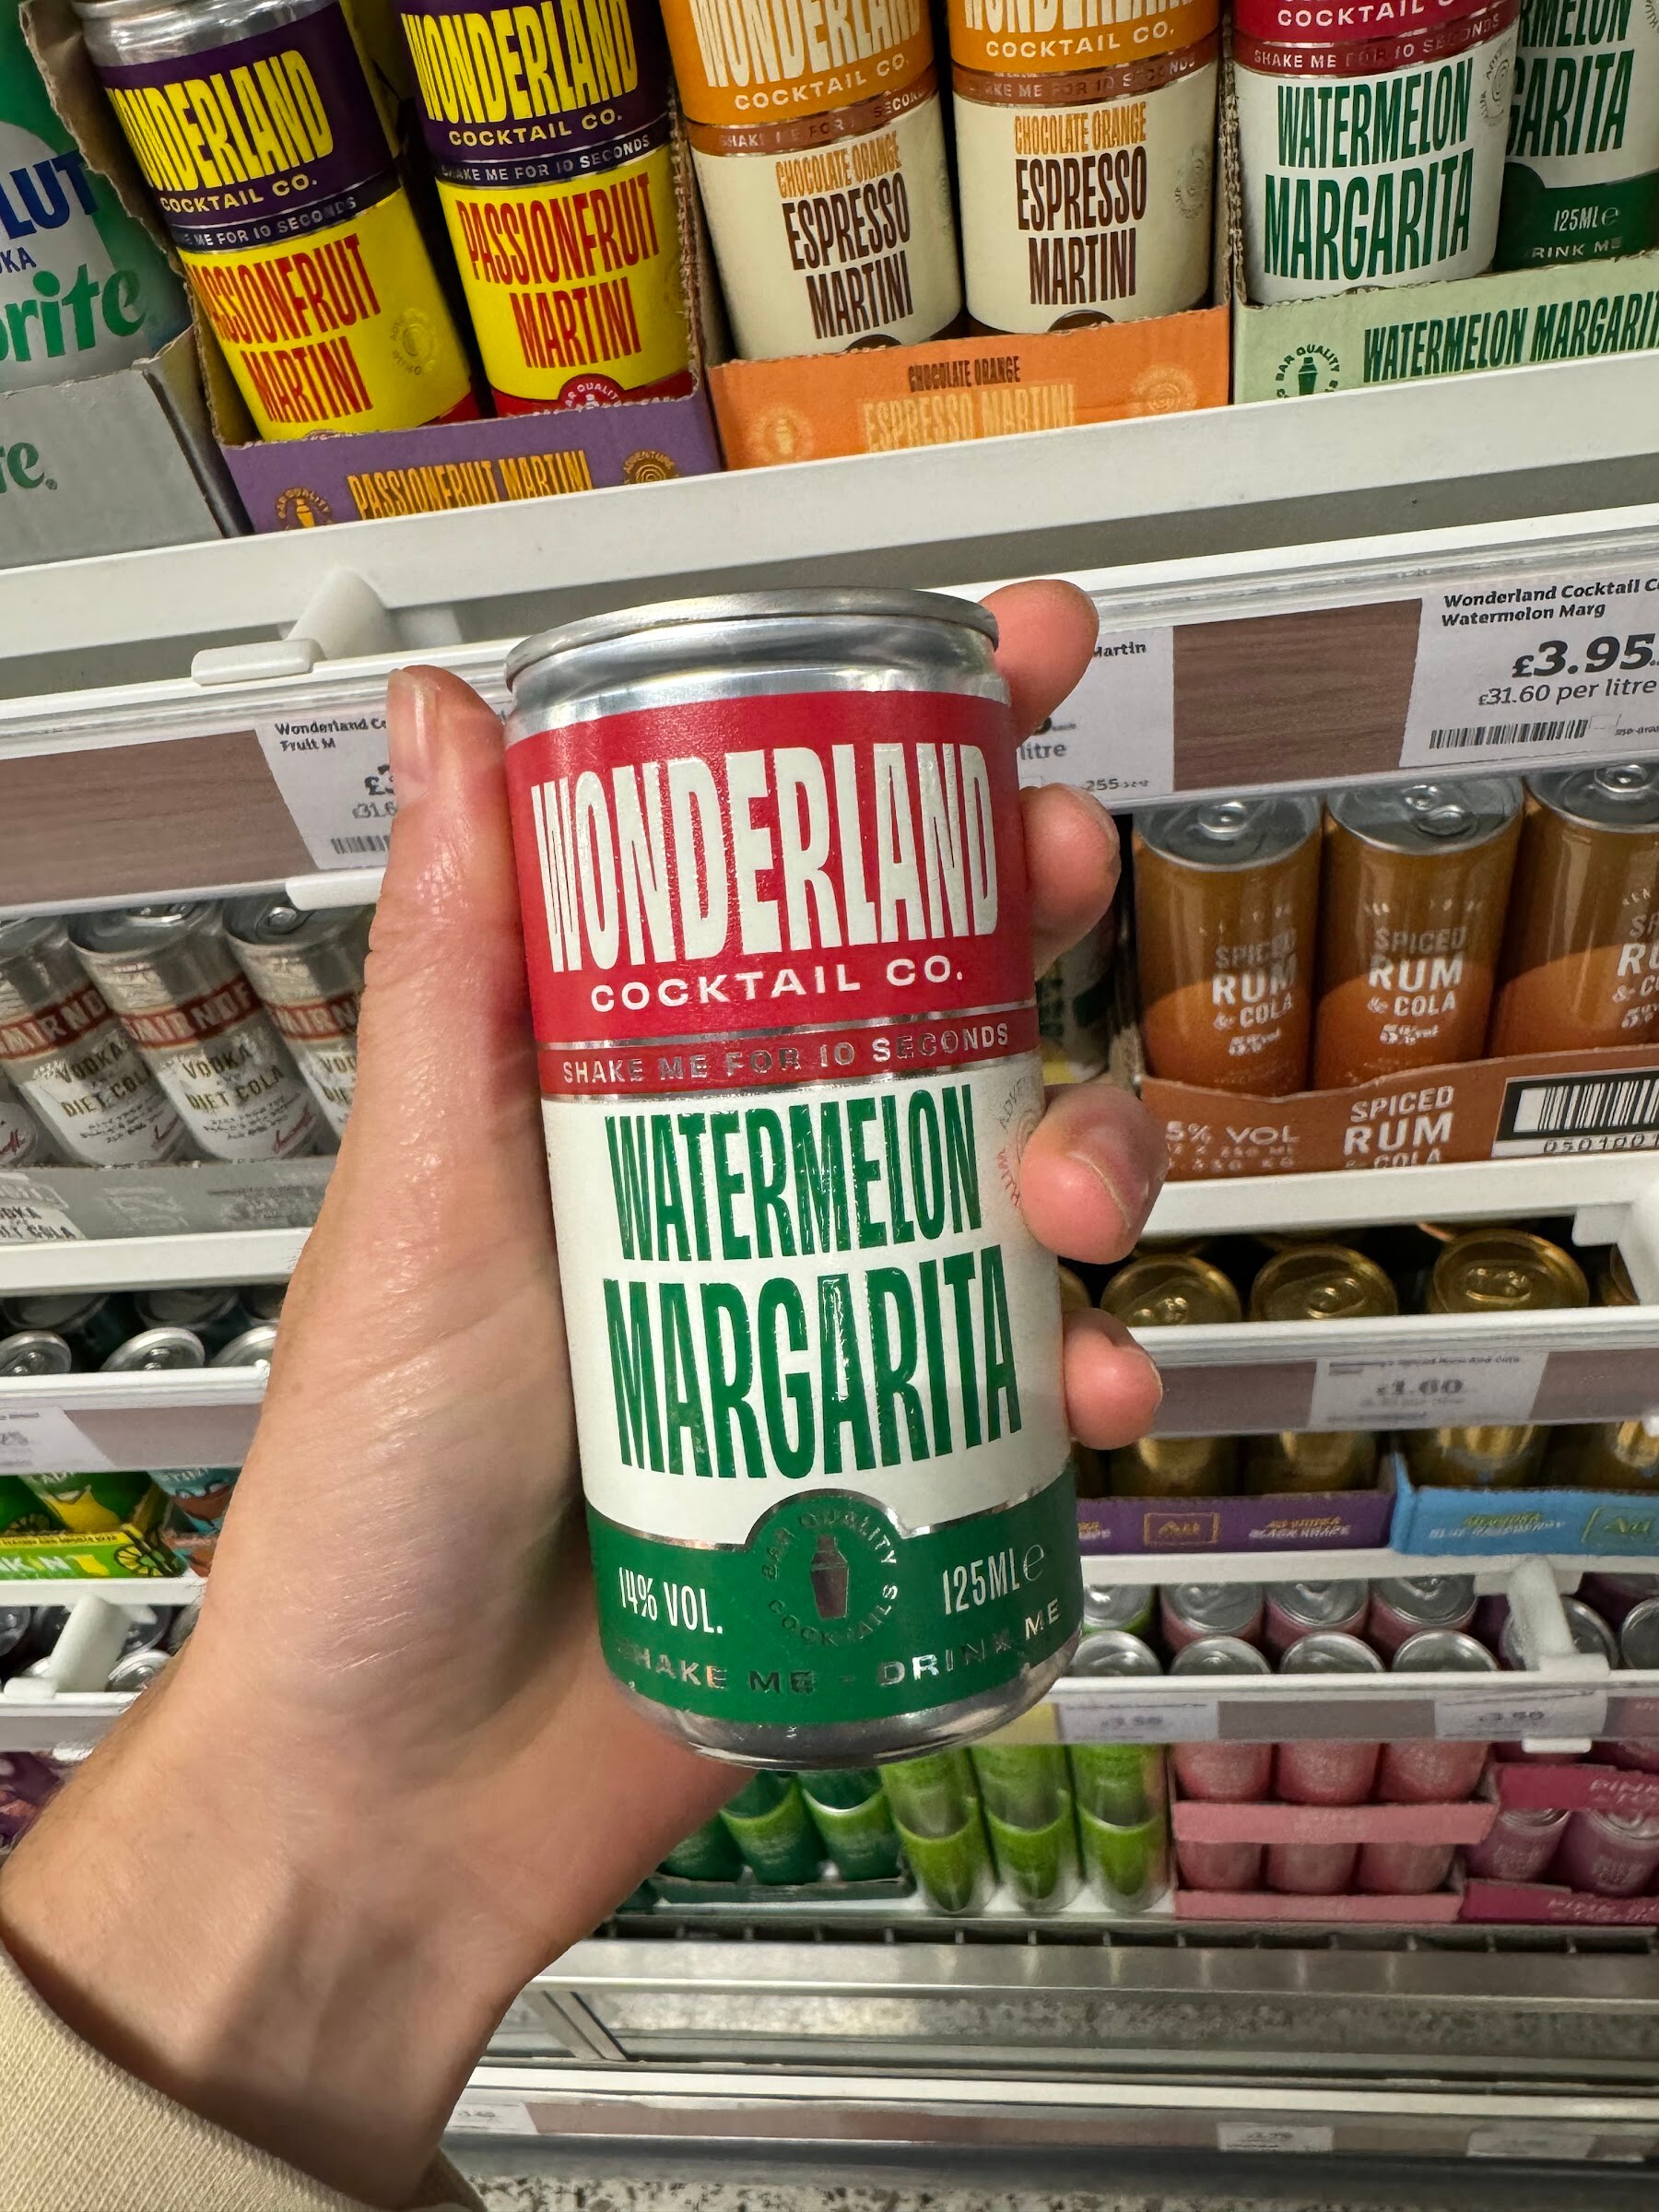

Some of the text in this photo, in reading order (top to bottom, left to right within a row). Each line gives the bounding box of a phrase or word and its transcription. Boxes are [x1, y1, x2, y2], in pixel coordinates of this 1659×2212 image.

[1277, 0, 1424, 27] COCKTAIL
[401, 0, 638, 124] WONDERLAND
[986, 21, 1174, 58] COCKTAIL CO.
[1253, 50, 1302, 68] SHAKE
[1311, 55, 1336, 68] ME
[1394, 42, 1415, 60] 10
[735, 70, 867, 111] COCKTAIL
[970, 81, 1012, 97] AKE
[1018, 84, 1042, 97] ME
[1123, 57, 1195, 88] SCNDS
[873, 88, 926, 117] SECON
[1277, 56, 1474, 170] WATERMELON
[449, 108, 622, 147] COCKTAIL CO.
[1015, 101, 1147, 155] CHOCOLATE ORANGE
[486, 167, 509, 182] ME
[514, 163, 550, 179] FOR
[556, 159, 574, 174] 10
[580, 135, 650, 168] SECONDS
[775, 130, 901, 198] CHOCOLATE ORANGE
[159, 173, 317, 213] COCKTAIL CO.
[1016, 146, 1147, 231] ESPRESSO
[218, 229, 249, 244] FOR
[253, 225, 271, 240] 10
[278, 196, 357, 232] SECONDS
[455, 173, 659, 285] PASSIONFRUIT
[782, 172, 910, 270] ESPRESSO
[1265, 147, 1475, 281] MARGARITA
[0, 247, 36, 274] KA
[1029, 228, 1136, 305] MARTINI
[1525, 237, 1622, 259] RINK ME
[806, 250, 913, 339] MARTINI
[510, 276, 642, 369] MARTINI
[1364, 307, 1528, 382] WATERMELON
[241, 335, 373, 423] MARTINI
[908, 356, 1020, 392] CHOCOLATE ORANGE
[1276, 344, 1339, 381] BAR QUALITY
[864, 393, 973, 453] ESPRESSO
[982, 383, 1075, 437] MARTINI
[347, 450, 593, 520] PASSIONFRUIT MARTINI
[1441, 603, 1606, 627] Watermelon Marg
[1444, 586, 1556, 607] Wonderland
[1562, 579, 1641, 598] Cocktail
[1512, 633, 1656, 677] £3.95
[1478, 678, 1657, 706] £31.60 per litre
[275, 718, 369, 735] Wonderland
[279, 737, 336, 752] Fruit M
[1020, 743, 1067, 760] litre
[531, 743, 997, 972] WONDERLAND
[1374, 926, 1467, 956] SPICED
[591, 956, 963, 1013] COCKTAIL CO.
[1212, 959, 1297, 1006] RUM
[1369, 955, 1464, 993] RUM
[1240, 994, 1292, 1028] COLA
[1394, 991, 1458, 1018] COLA
[57, 1042, 124, 1084] VODKA
[182, 1042, 253, 1080] VODKA
[563, 1023, 1008, 1084] SHAKE ME FOR 10 SECONDS
[60, 1096, 105, 1118] DIET
[184, 1065, 284, 1111] DIET COLA
[1350, 1086, 1454, 1123] SPICED
[1226, 1125, 1299, 1145] VOL
[1344, 1112, 1454, 1156] RUM
[605, 1084, 982, 1261] WATERMELON
[603, 1244, 1022, 1478] MARGARITA
[762, 1509, 897, 1581] BAR QUALITY
[618, 1567, 723, 1634] 14% VOL.
[941, 1547, 1019, 1615] 125ML
[769, 1584, 898, 1646] COCKTAILS
[748, 1670, 816, 1694] ME
[879, 1630, 1013, 1688] DRINK
[1024, 1598, 1060, 1640] ME
